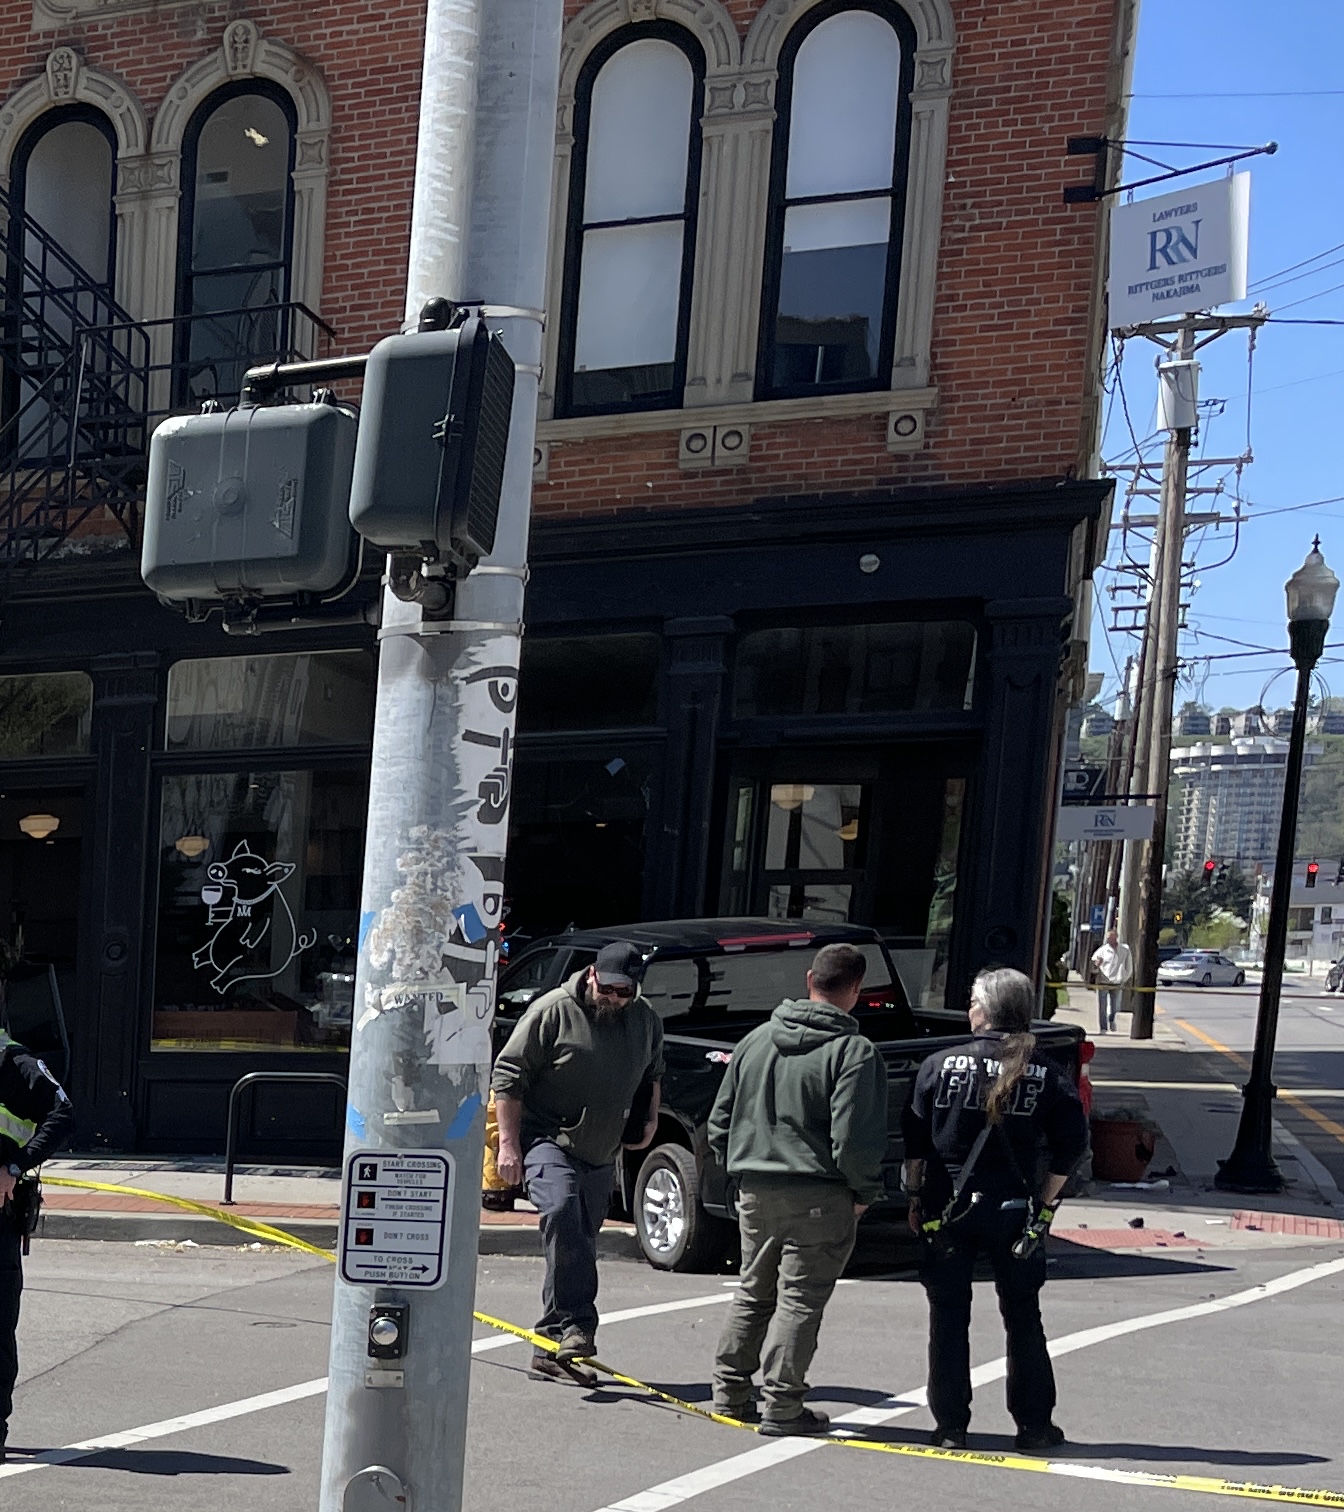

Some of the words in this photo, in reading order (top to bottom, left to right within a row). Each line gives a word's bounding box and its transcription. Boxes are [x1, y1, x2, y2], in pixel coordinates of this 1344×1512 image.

[1152, 202, 1198, 223] LAWYERS
[1128, 276, 1176, 296] RITTGERS
[1178, 263, 1227, 284] RITTGERS
[1152, 283, 1201, 303] NAKAJIMA
[394, 992, 443, 1004] WANTED
[935, 1068, 1045, 1116] FIE
[407, 1161, 442, 1169] CROSSING
[410, 1190, 432, 1198] START
[387, 1256, 413, 1264] CROSS
[389, 1271, 420, 1279] BUTTON
